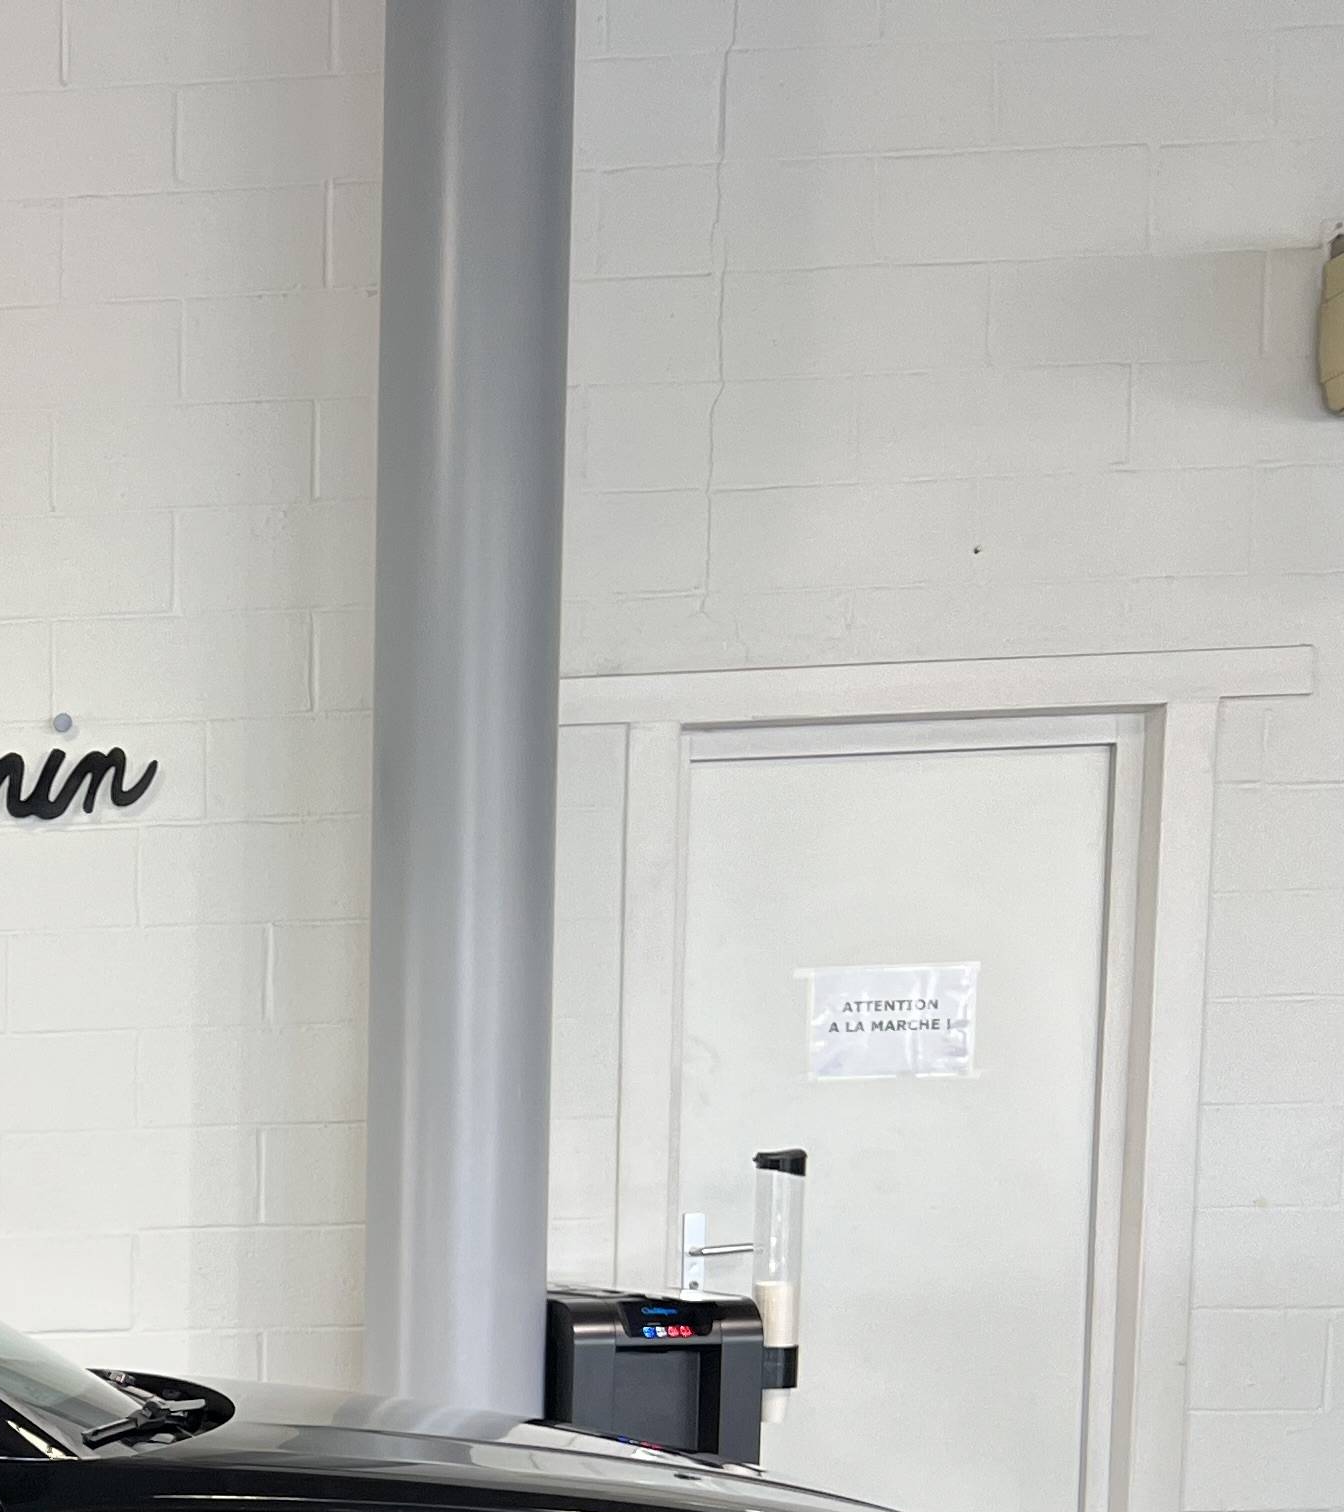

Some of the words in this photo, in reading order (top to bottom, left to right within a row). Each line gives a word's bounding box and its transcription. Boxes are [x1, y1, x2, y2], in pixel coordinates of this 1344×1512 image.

[842, 999, 939, 1013] ATTENTION
[828, 1021, 840, 1033] A
[845, 1020, 865, 1033] LA
[871, 1018, 941, 1032] MARCHE
